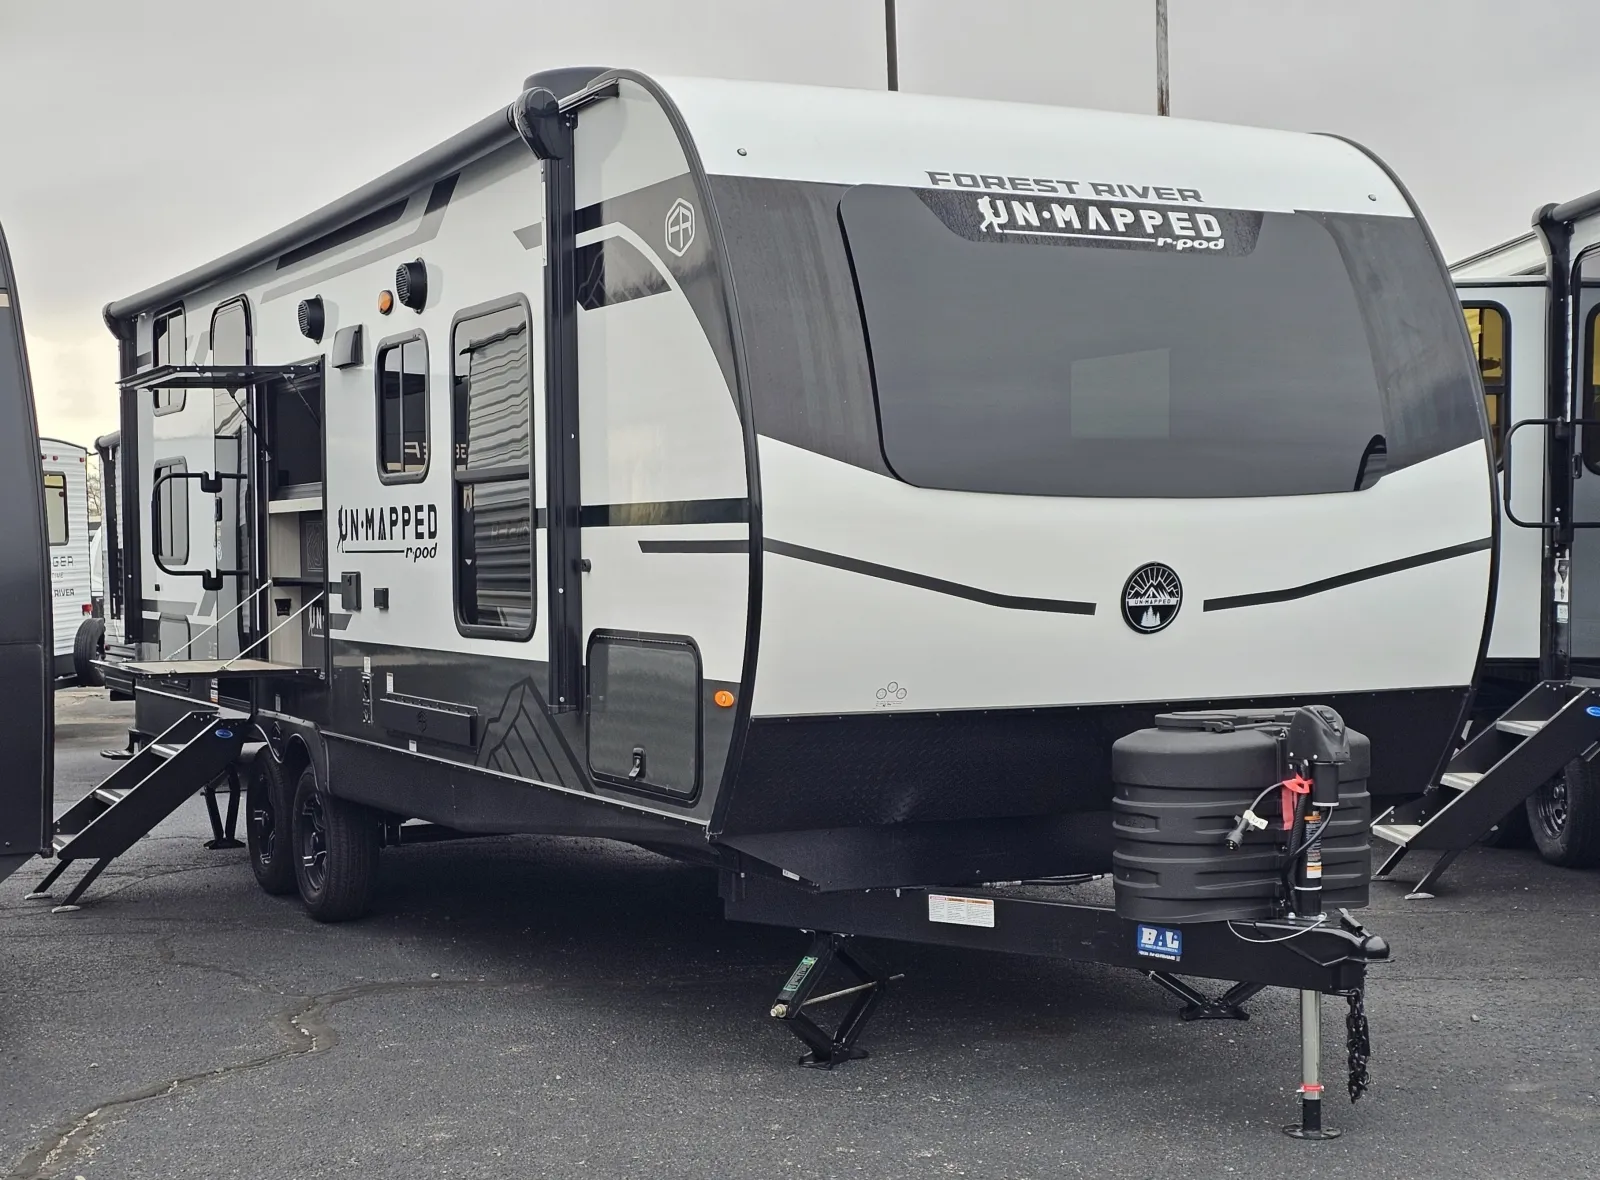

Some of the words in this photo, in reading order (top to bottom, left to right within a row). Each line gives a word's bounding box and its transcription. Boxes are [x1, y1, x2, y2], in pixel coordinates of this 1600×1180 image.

[924, 171, 1080, 195] FOREST
[1087, 182, 1204, 203] RIVER
[52, 556, 74, 567] GER
[54, 588, 75, 598] RIVER
